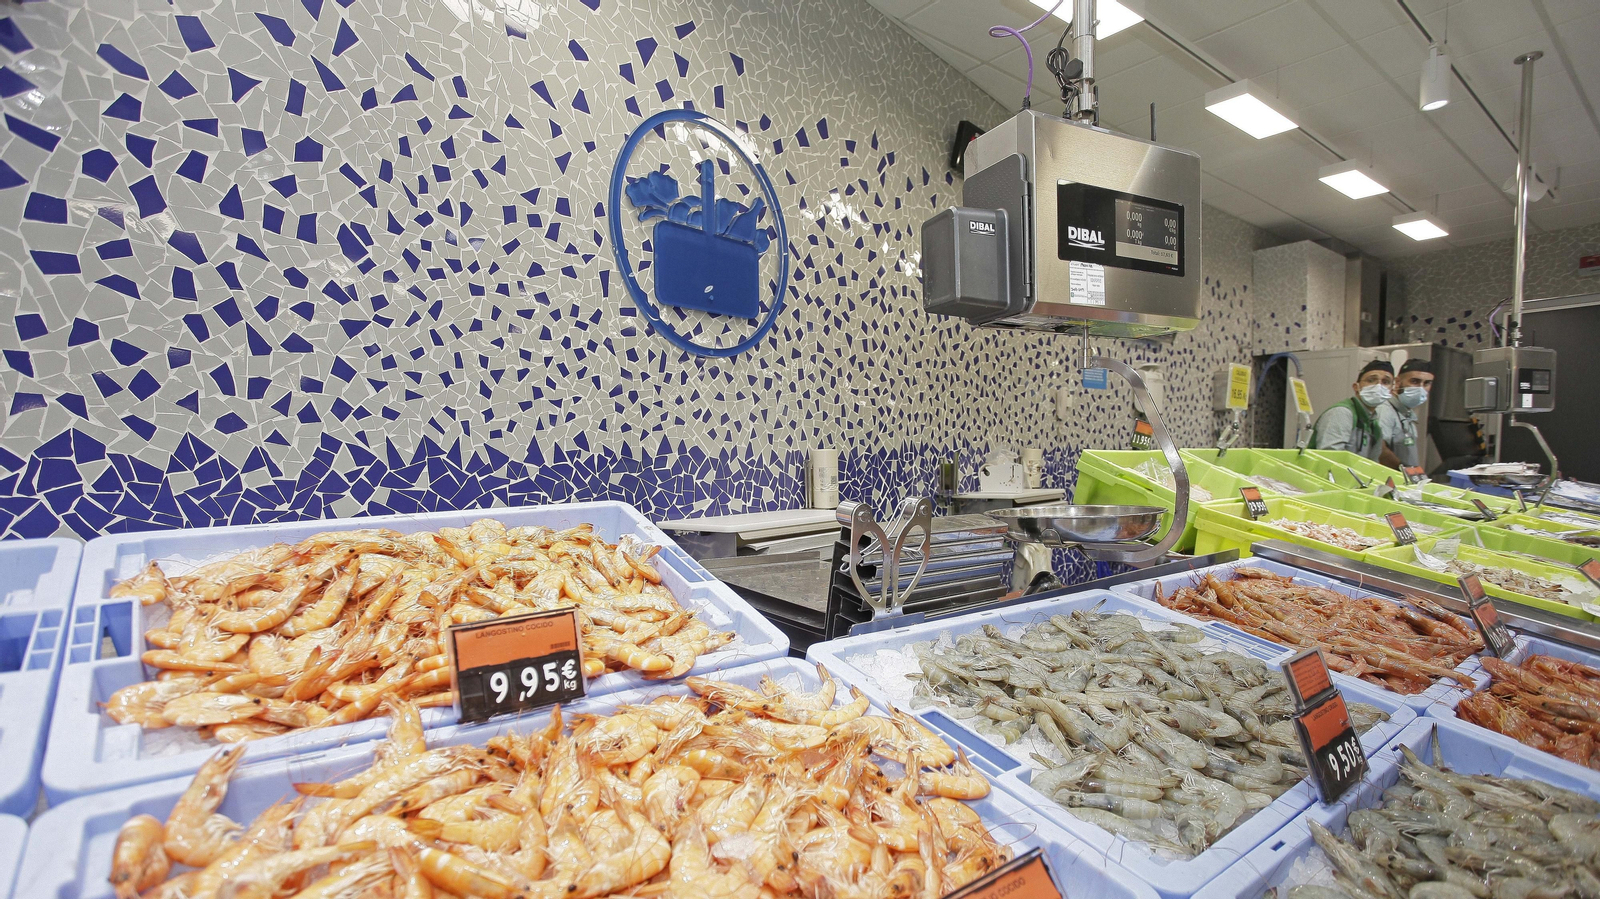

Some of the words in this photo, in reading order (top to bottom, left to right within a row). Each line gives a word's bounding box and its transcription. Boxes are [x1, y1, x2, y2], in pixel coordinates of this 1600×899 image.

[969, 221, 995, 232] DIBAL
[1068, 226, 1105, 244] DIBAL
[476, 627, 523, 639] LANGOSTINO
[526, 621, 554, 631] COCIDO
[564, 680, 577, 690] kg
